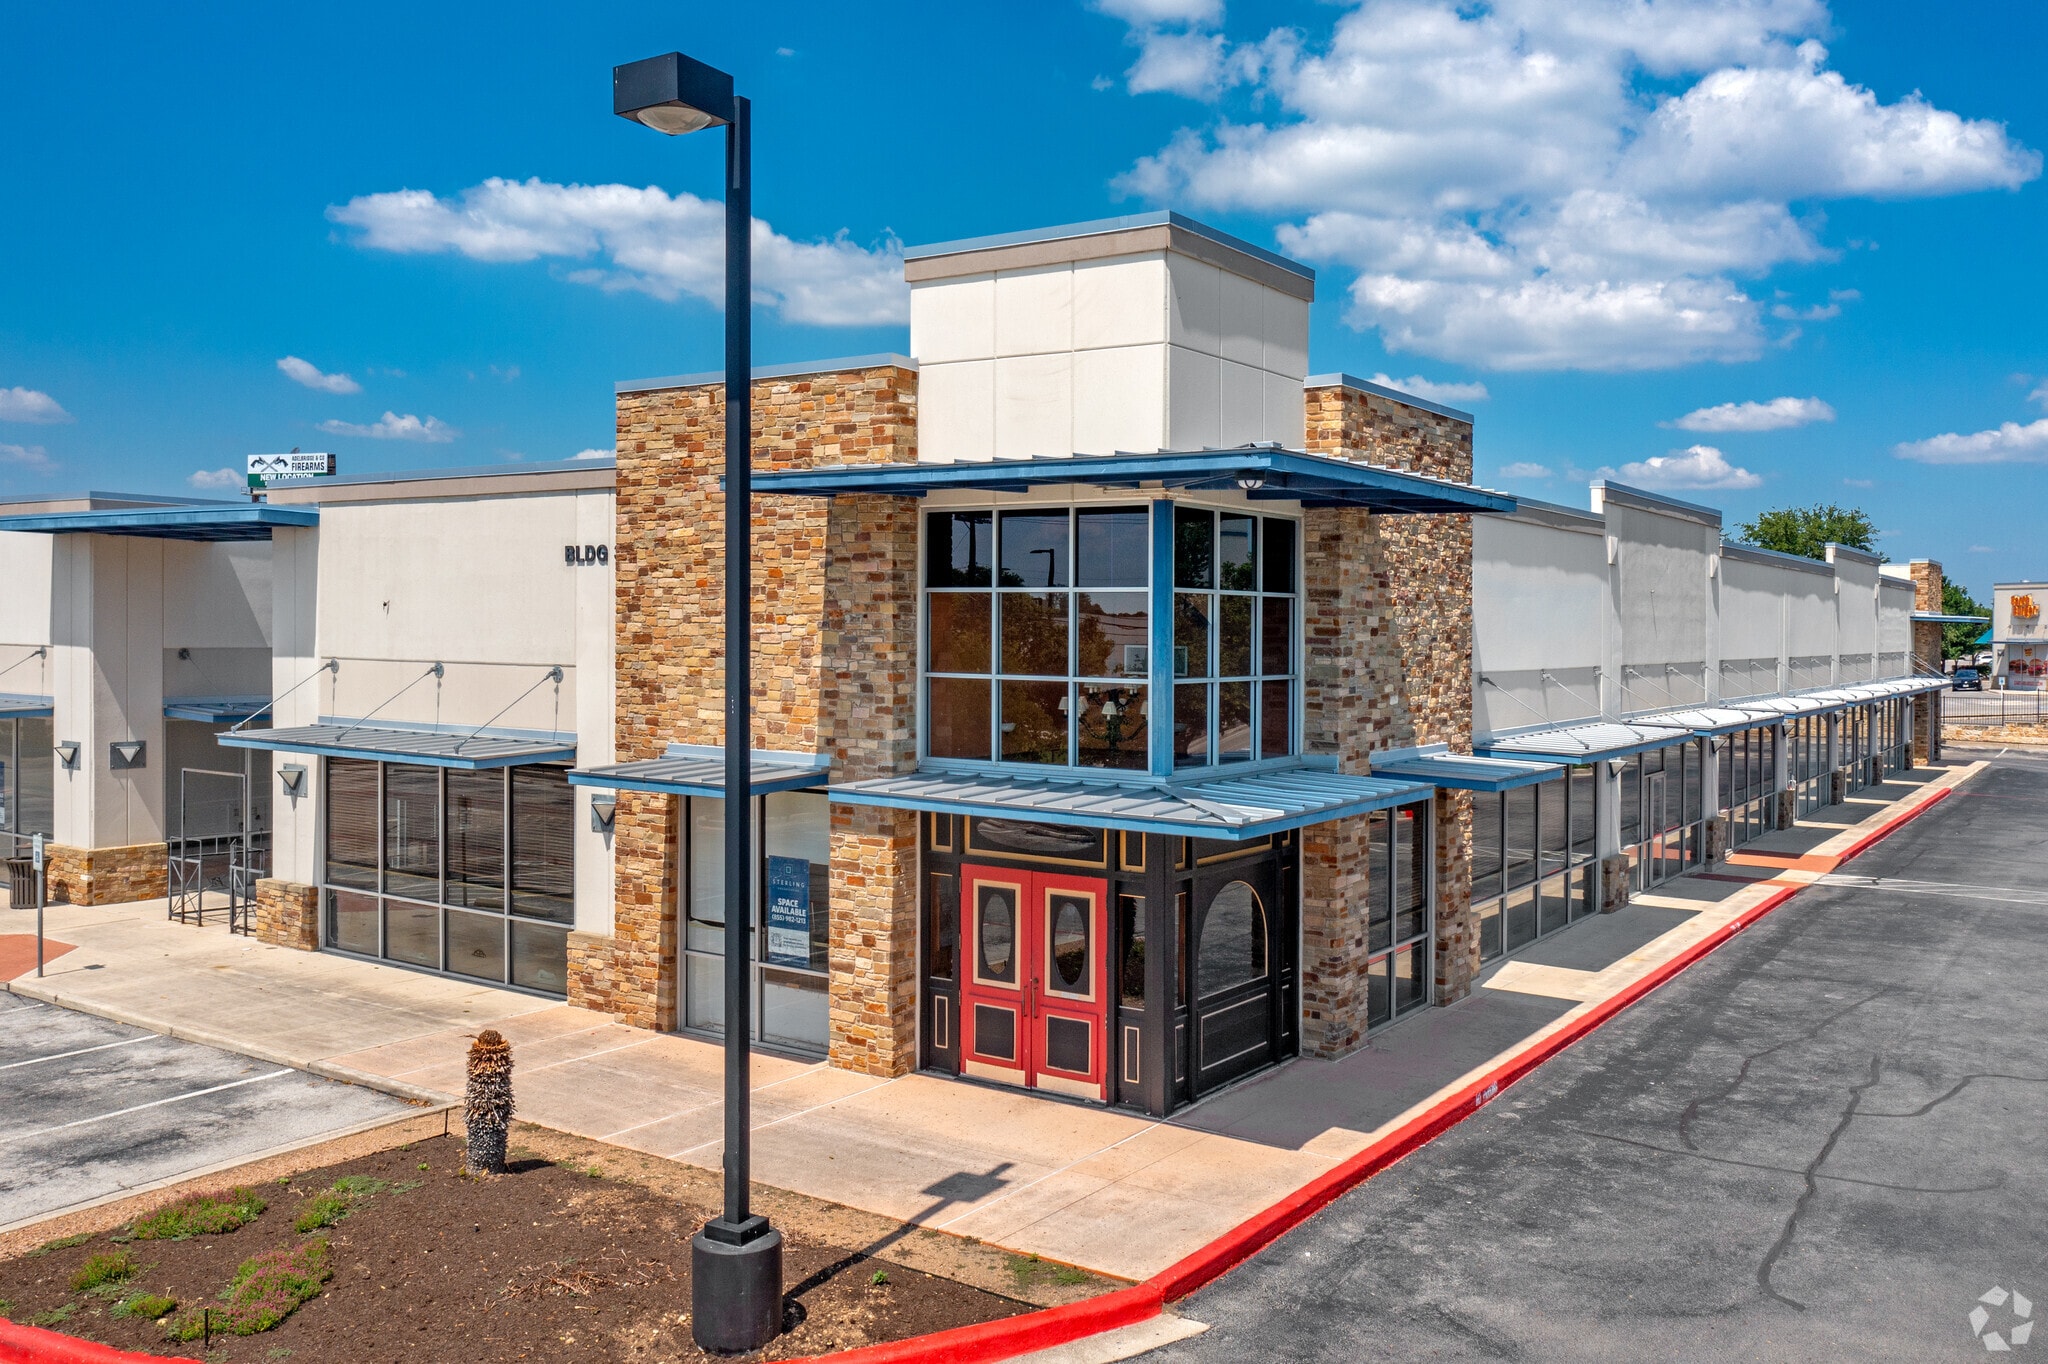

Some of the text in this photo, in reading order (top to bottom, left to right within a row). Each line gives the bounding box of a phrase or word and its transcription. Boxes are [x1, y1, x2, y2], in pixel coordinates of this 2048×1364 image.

[291, 462, 325, 471] FIREARMS
[260, 473, 276, 481] NEW
[564, 544, 609, 562] BLDG
[772, 878, 805, 888] STERLING
[777, 898, 799, 908] SPACE
[771, 905, 807, 917] AVAILABLE
